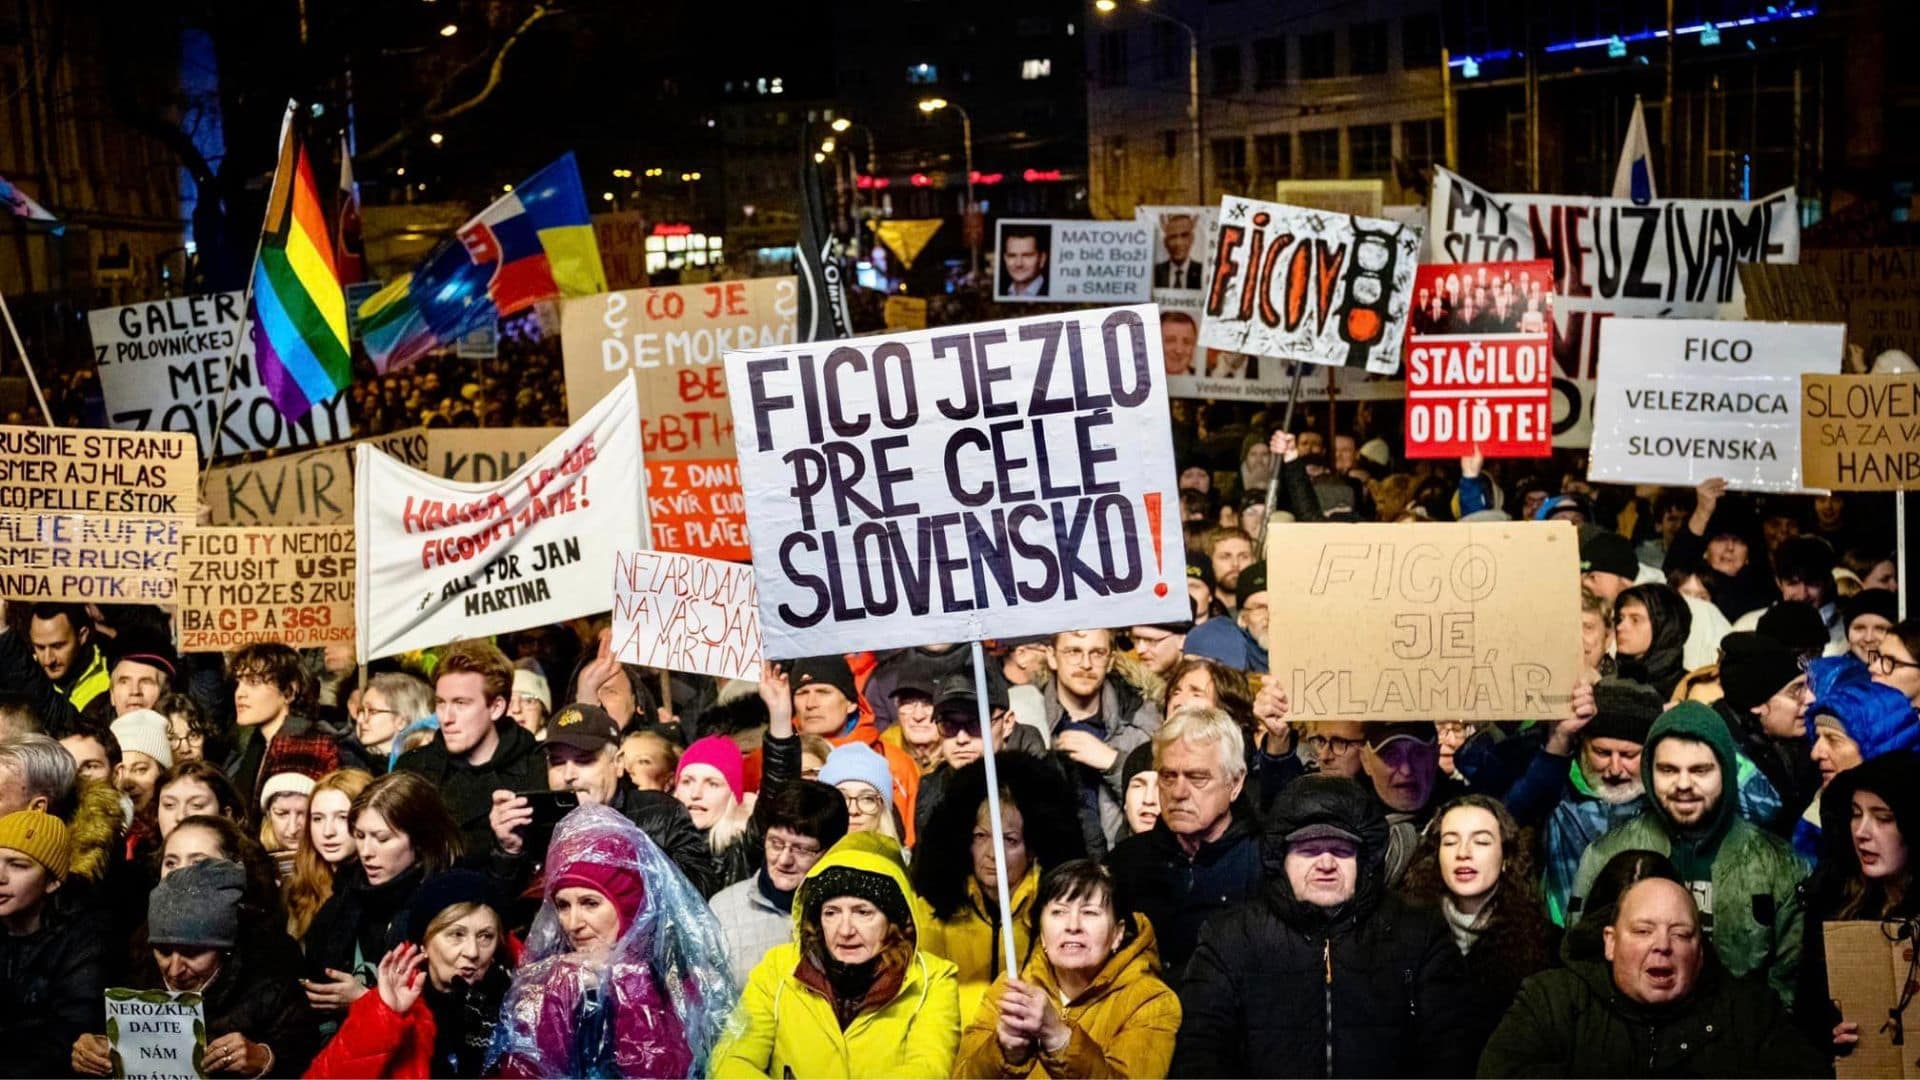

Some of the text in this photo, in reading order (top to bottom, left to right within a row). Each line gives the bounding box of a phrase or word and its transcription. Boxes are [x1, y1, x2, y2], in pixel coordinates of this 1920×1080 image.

[1062, 229, 1147, 245] MATOVIČ
[1058, 247, 1075, 264] je
[1060, 265, 1145, 278] na MAFIU
[704, 282, 748, 318] JE
[1066, 281, 1137, 294] a SMER
[118, 293, 255, 338] GALÉR
[1410, 341, 1547, 385] STAČILO!
[1684, 337, 1753, 363] FICO
[168, 354, 266, 400] MEN
[745, 309, 1152, 453] FICO JE ZLO
[1625, 389, 1789, 414] VELEZRADCA
[1410, 397, 1547, 442] ODÍĎTE!
[83, 435, 183, 459] STRANU
[1820, 423, 1849, 447] SA
[1856, 423, 1892, 446] ZA
[1628, 436, 1778, 461] SLOVENSKA
[64, 461, 97, 484] AJ
[101, 463, 166, 488] HLAS
[660, 465, 678, 488] Z
[782, 407, 1121, 531] PRE CELÉ
[106, 488, 177, 513] EŠTOK
[181, 534, 238, 556] FICO
[243, 533, 277, 555] TY
[483, 554, 523, 585] FOR
[531, 536, 581, 572] JAN
[1310, 543, 1497, 604] FICO
[182, 584, 214, 606] TY
[309, 581, 356, 607] ZRU
[464, 577, 552, 618] MARTINA
[182, 608, 215, 631] IBA
[263, 608, 278, 630] A
[281, 605, 332, 629] 363
[284, 628, 305, 643] DO
[616, 621, 640, 663] A
[1391, 611, 1476, 660] JE
[1291, 648, 1554, 715] KLAMÁR
[109, 1002, 200, 1017] NEROZKLA
[129, 1021, 182, 1034] DAJTE
[140, 1044, 177, 1060] NÁM
